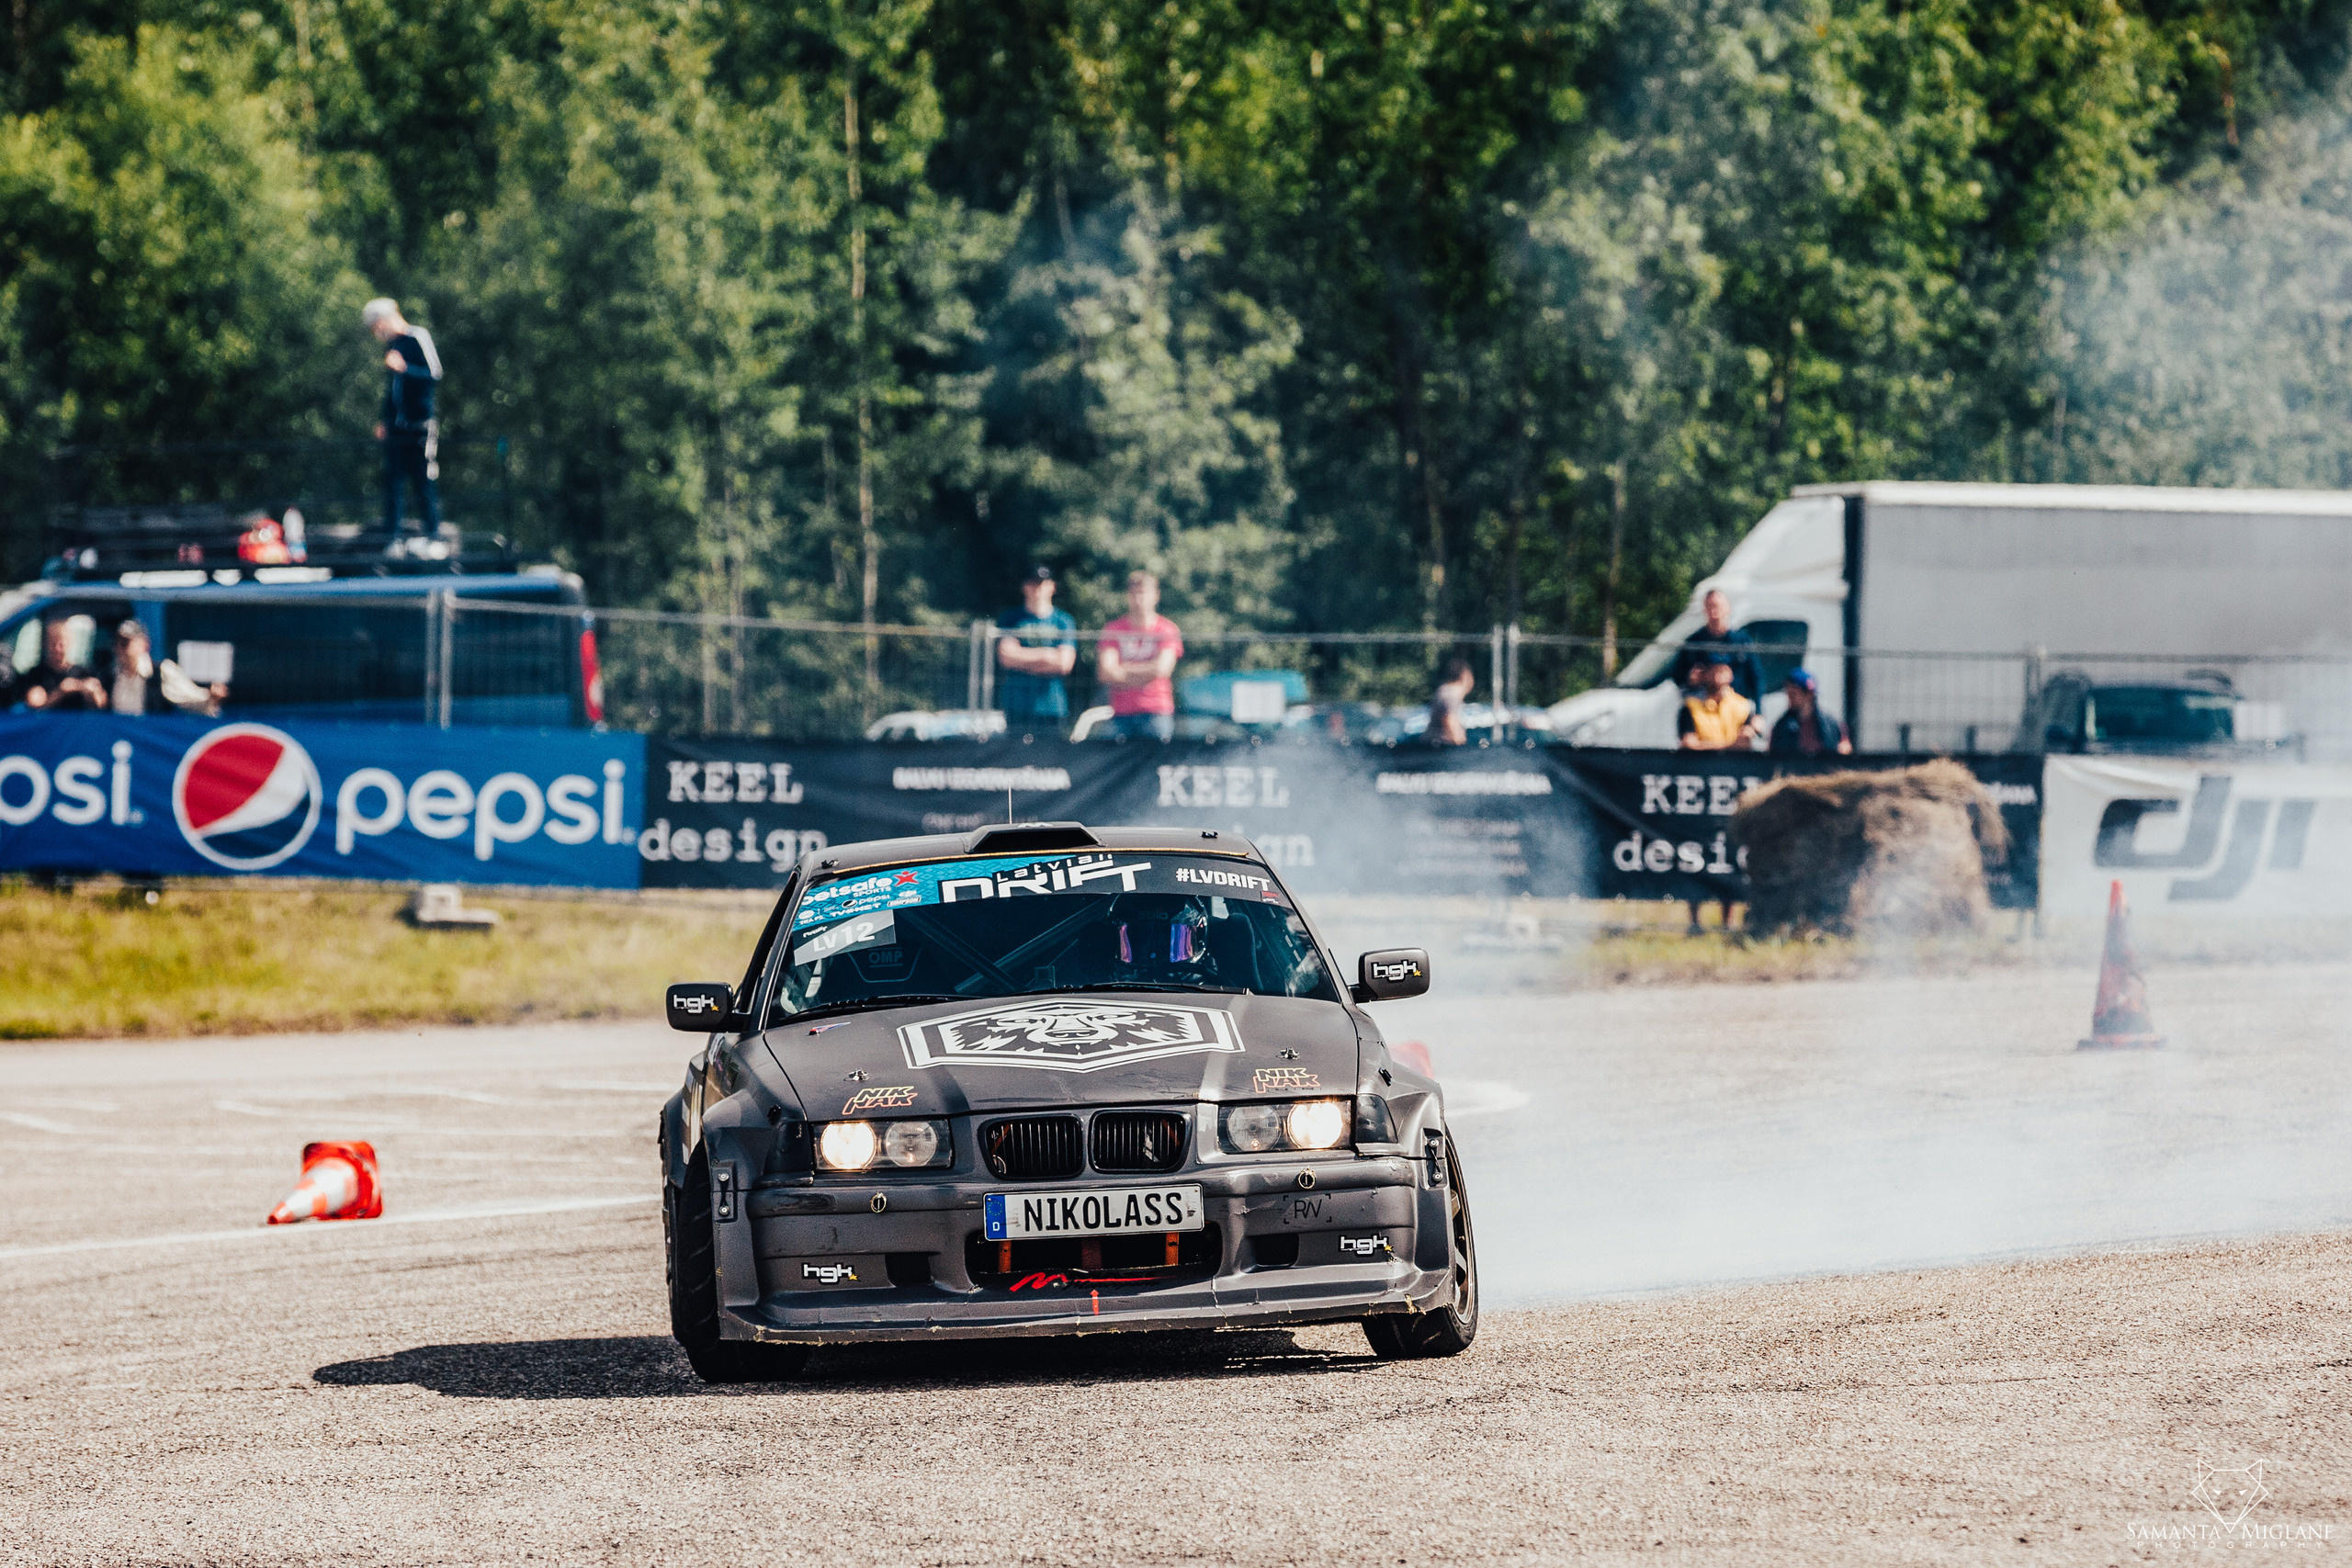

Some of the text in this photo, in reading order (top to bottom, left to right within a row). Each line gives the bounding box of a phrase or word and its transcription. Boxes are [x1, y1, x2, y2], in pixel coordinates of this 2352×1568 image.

[667, 761, 804, 805] KEEL
[1156, 764, 1290, 808] KEEL
[334, 759, 626, 862] pepsi
[638, 817, 828, 873] design
[942, 860, 1152, 904] DRIFT
[1175, 867, 1271, 892] #LVDRIFT
[853, 886, 892, 898] SPORTS
[867, 951, 904, 964] OMP
[1373, 960, 1418, 981] hgk
[673, 994, 715, 1014] hgk
[1255, 1067, 1309, 1082] NIK
[853, 1086, 915, 1103] NIK
[1023, 1191, 1183, 1232] NIKOLASS
[992, 1222, 1001, 1232] D
[1340, 1235, 1388, 1255] hgk
[803, 1263, 853, 1283] hgk
